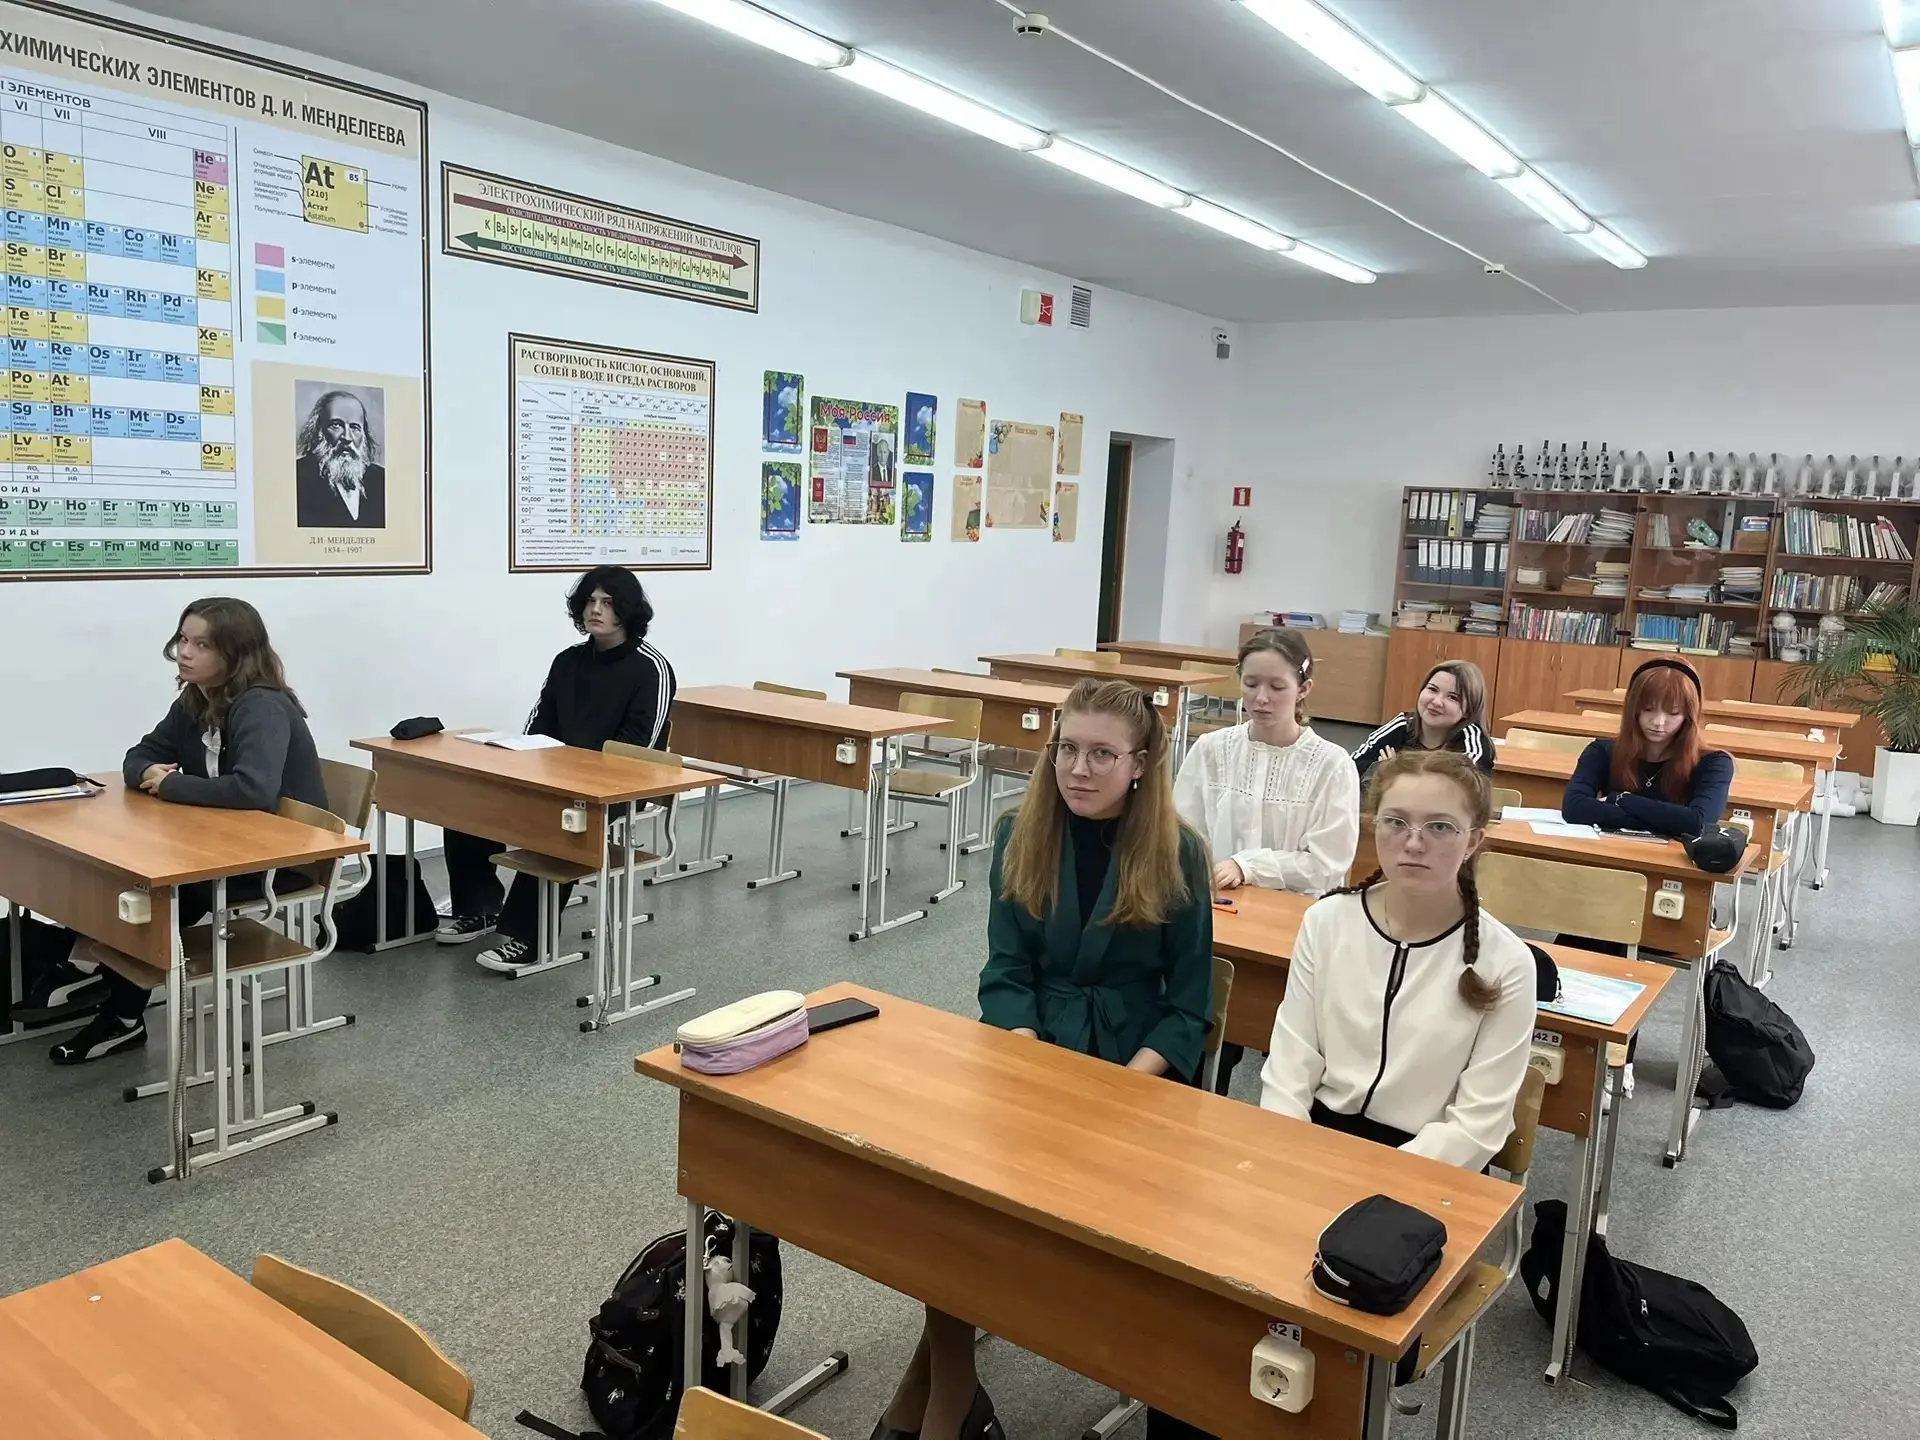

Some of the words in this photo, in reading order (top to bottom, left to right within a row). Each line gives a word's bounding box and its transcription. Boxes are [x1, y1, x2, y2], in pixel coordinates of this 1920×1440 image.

[0, 30, 141, 82] ХИМИЧЕСКИХ
[147, 67, 256, 115] ЭЛЕМЕНТОВ
[261, 95, 277, 116] Д.
[282, 101, 297, 120] И.
[302, 106, 406, 147] МЕНДЕЛЕЕВА
[8, 82, 91, 108] ЭЛЕМЕНТОВ
[15, 100, 28, 111] VI
[54, 108, 70, 120] VII
[148, 128, 167, 140] VIII
[3, 145, 17, 158] O
[194, 151, 214, 165] He
[45, 153, 55, 164] F
[305, 162, 335, 189] At
[348, 173, 359, 182] 85
[5, 178, 15, 190] S
[195, 181, 215, 195] Ne
[46, 186, 61, 198] Cl
[307, 201, 328, 212] Астат
[6, 211, 25, 224] Cr
[47, 217, 70, 231] Mn
[196, 211, 214, 224] Ar
[478, 183, 604, 224] ЭЛЕКТРОХИМИЧЕСКИЙ
[607, 213, 625, 230] РЯД
[627, 220, 693, 244] НАПРЯЖЕНИЙ
[695, 233, 742, 255] МЕТАЛЛОВ
[87, 223, 105, 236] Fe
[124, 229, 144, 242] Co
[161, 235, 177, 247] Ni
[7, 243, 28, 257] Se
[48, 249, 66, 261] Br
[484, 219, 491, 231] K
[496, 221, 506, 233] Ba
[510, 224, 519, 236] Sr
[522, 227, 532, 239] Ca
[534, 230, 545, 242] Na
[547, 232, 558, 246] Mg
[560, 236, 569, 247] Al
[571, 237, 581, 249] Mn
[583, 240, 593, 251] Zn
[595, 243, 604, 254] Cr
[606, 246, 615, 257] Fe
[617, 248, 626, 260] Cd
[628, 250, 637, 262] Co
[640, 253, 648, 264] Ni
[650, 256, 659, 266] Sn
[660, 258, 669, 268] Pb
[670, 260, 681, 271] (H)
[681, 262, 690, 273] Cu
[691, 264, 700, 276] Hg
[701, 266, 710, 278] Ag
[711, 268, 720, 278] Pt
[720, 271, 729, 281] Au
[500, 243, 572, 263] ВОССТАНОВИТЕЛЬНАЯ
[572, 257, 616, 274] СПОСОБНОСТЬ
[8, 275, 32, 289] Mo
[198, 270, 214, 282] Kr
[48, 280, 68, 293] Tc
[88, 285, 109, 298] Ru
[126, 290, 146, 303] Rh
[163, 294, 182, 307] Pd
[8, 307, 30, 321] Te
[199, 328, 218, 341] Xe
[10, 339, 27, 352] W
[51, 343, 72, 356] Re
[90, 346, 110, 359] Os
[127, 350, 142, 362] Ir
[165, 354, 181, 367] Pt
[520, 349, 608, 369] РАСТВОРИМОСТЬ
[609, 358, 650, 375] КИСЛОТ,
[650, 366, 708, 383] ОСНОВАНИЙ,
[11, 371, 32, 383] Po
[52, 374, 70, 386] At
[533, 363, 571, 378] СОЛЕЙ
[571, 369, 579, 379] В
[579, 370, 606, 382] ВОДЕ
[606, 373, 615, 382] И
[615, 373, 646, 387] СРЕДА
[647, 377, 697, 393] РАСТВОРОВ
[201, 386, 220, 398] Rn
[12, 402, 32, 416] Sg
[53, 405, 74, 417] Bh
[91, 407, 112, 420] Hs
[819, 402, 846, 419] Моя
[848, 405, 891, 424] Россия
[130, 410, 149, 422] Mt
[166, 412, 185, 425] Ds
[14, 434, 32, 446] Lv
[53, 436, 72, 448] Ts
[202, 444, 222, 457] Og
[28, 499, 48, 511] Dy
[66, 500, 87, 511] Ho
[103, 501, 118, 511] Er
[138, 501, 158, 511] Tm
[172, 502, 190, 512] Yb
[206, 503, 221, 513] Lu
[30, 540, 47, 552] Cf
[68, 541, 85, 551] Es
[104, 541, 124, 551] Fm
[139, 541, 159, 551] Md
[174, 541, 193, 551] No
[207, 541, 220, 551] Lr
[1734, 809, 1743, 817] 42
[1533, 1032, 1548, 1042] 42
[1269, 1323, 1288, 1337] 42
